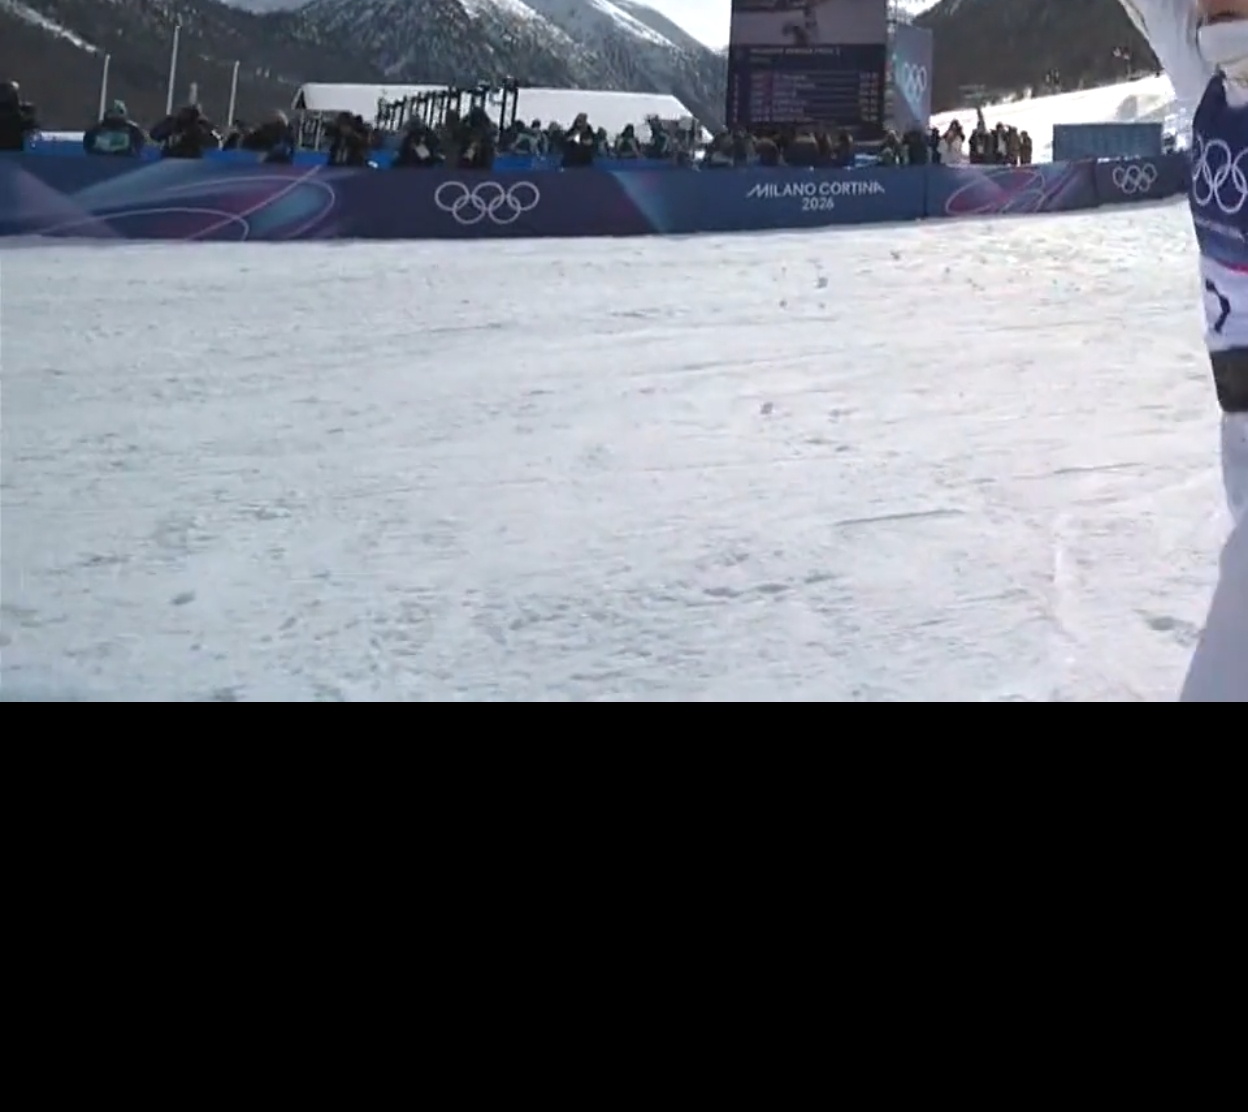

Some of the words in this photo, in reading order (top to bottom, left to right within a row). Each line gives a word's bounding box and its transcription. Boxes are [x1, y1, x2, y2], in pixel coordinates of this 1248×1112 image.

[747, 183, 816, 198] MILANO
[819, 181, 886, 195] CORTINA
[802, 198, 835, 210] 2026
